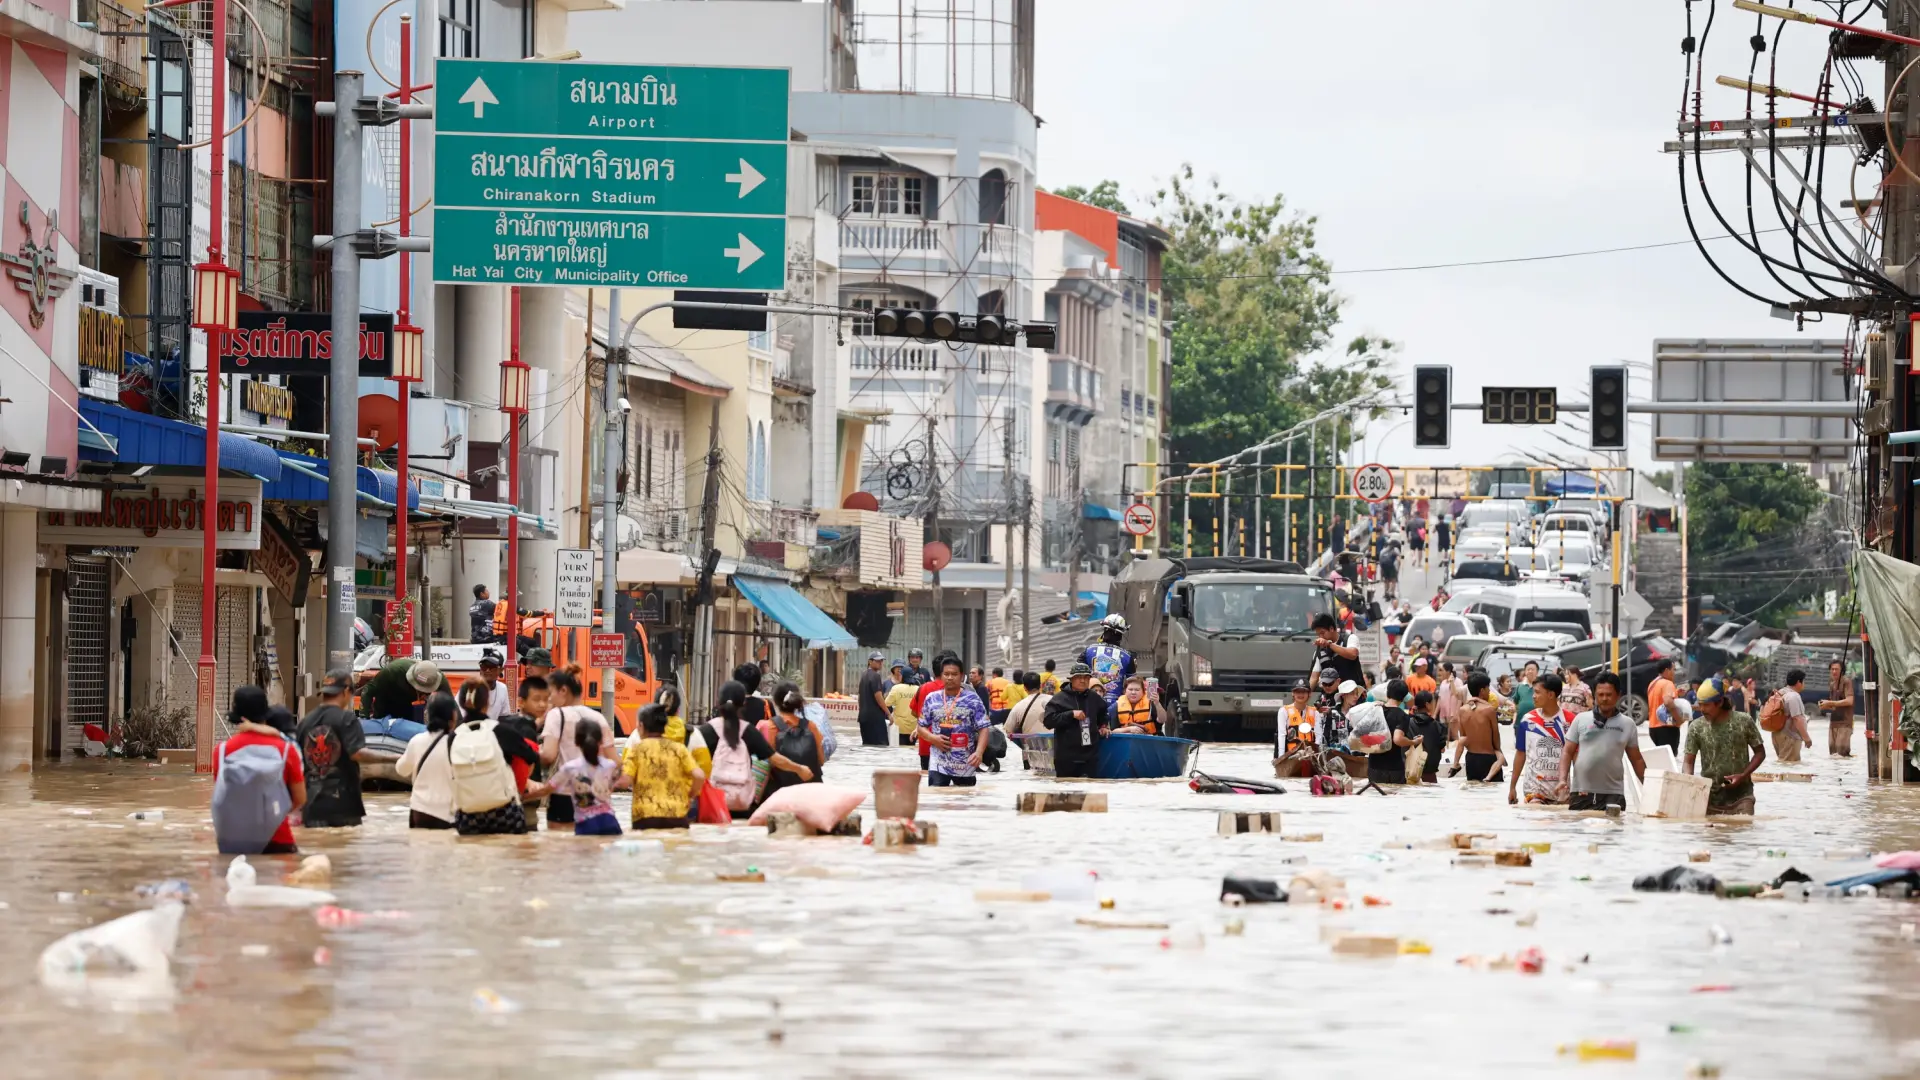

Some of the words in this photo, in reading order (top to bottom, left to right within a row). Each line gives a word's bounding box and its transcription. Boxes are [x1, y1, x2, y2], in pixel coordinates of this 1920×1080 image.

[571, 75, 677, 105] สนามบิน
[588, 115, 655, 129] Airport
[1837, 117, 1844, 125] C
[471, 147, 675, 181] สนามกีฬาจิรนคร
[483, 187, 580, 202] Chiranakorn
[591, 190, 656, 204] Stadium
[495, 212, 649, 240] สำนักงานเทศบาล
[493, 240, 608, 267] นครหาดใหญ่
[452, 265, 477, 278] Hat
[483, 266, 504, 278] Yai
[514, 267, 543, 281] City
[555, 268, 640, 284] Municipality
[647, 271, 688, 283] Office
[563, 563, 588, 571] TURN
[560, 585, 590, 598] ห้ามเลี้ยว
[562, 607, 587, 619] ไฟแดง
[430, 652, 451, 660] PRO
